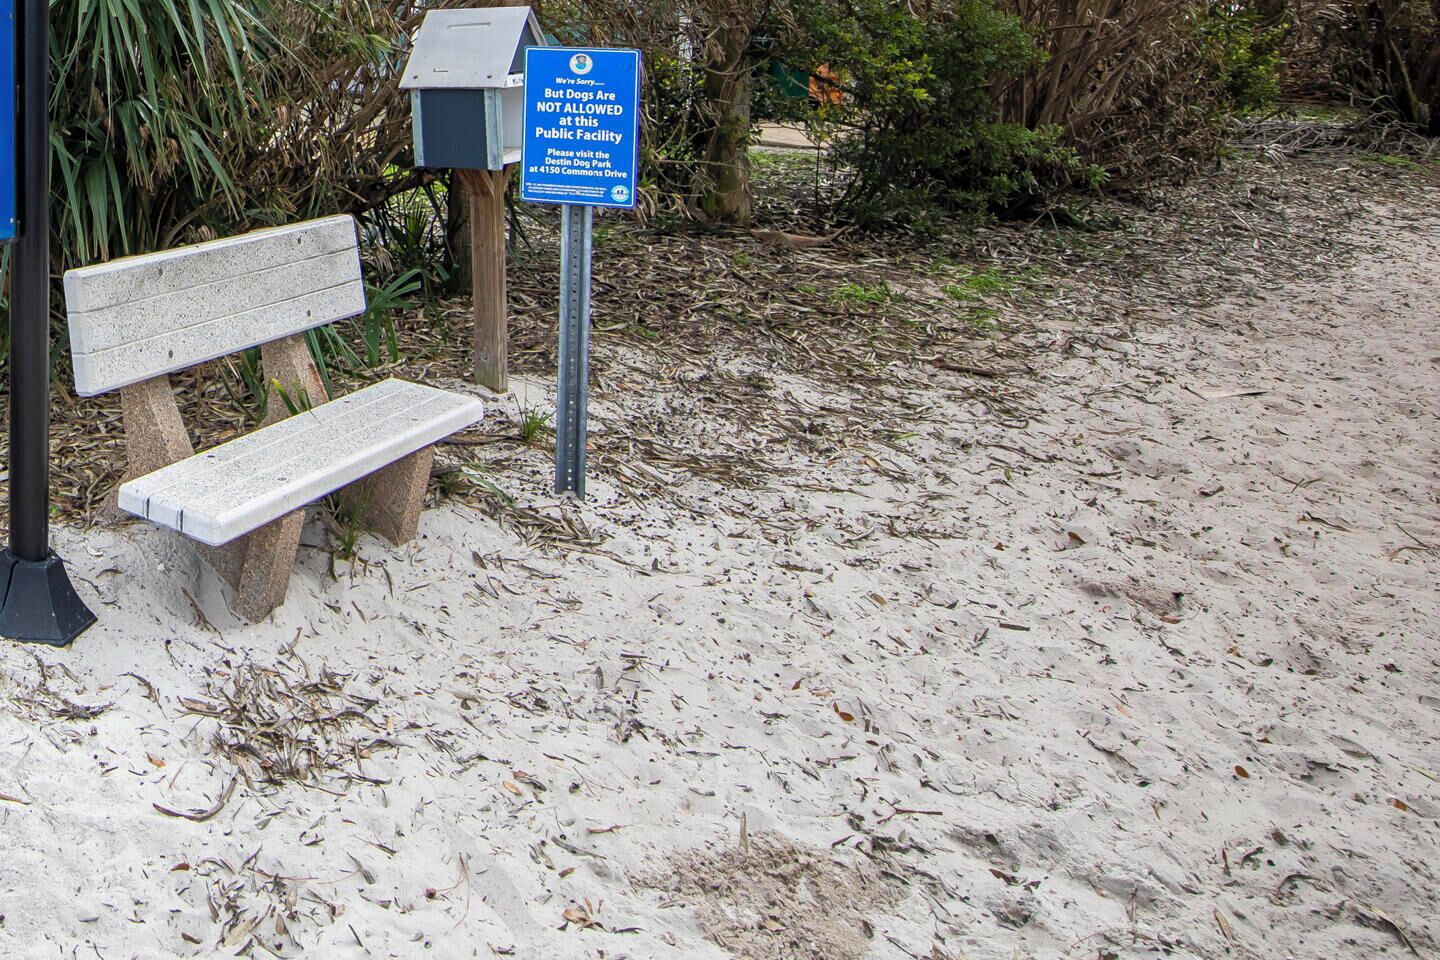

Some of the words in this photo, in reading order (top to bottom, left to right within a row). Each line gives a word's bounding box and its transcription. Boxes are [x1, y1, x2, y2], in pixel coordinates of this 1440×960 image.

[556, 77, 575, 85] We're
[544, 88, 564, 98] But
[566, 89, 594, 102] Dogs
[596, 90, 616, 100] Are
[536, 102, 562, 112] NOT
[564, 103, 623, 116] ALLOWED
[559, 116, 572, 126] at
[575, 116, 599, 127] this
[536, 127, 574, 140] Public
[576, 129, 622, 144] Facility
[548, 148, 574, 157] Please
[576, 150, 594, 158] visit
[596, 151, 610, 159] the
[545, 157, 572, 166] Destin
[574, 158, 590, 168] Dog
[592, 160, 612, 168] Park
[562, 168, 602, 176] Commons
[604, 170, 628, 178] Drive
